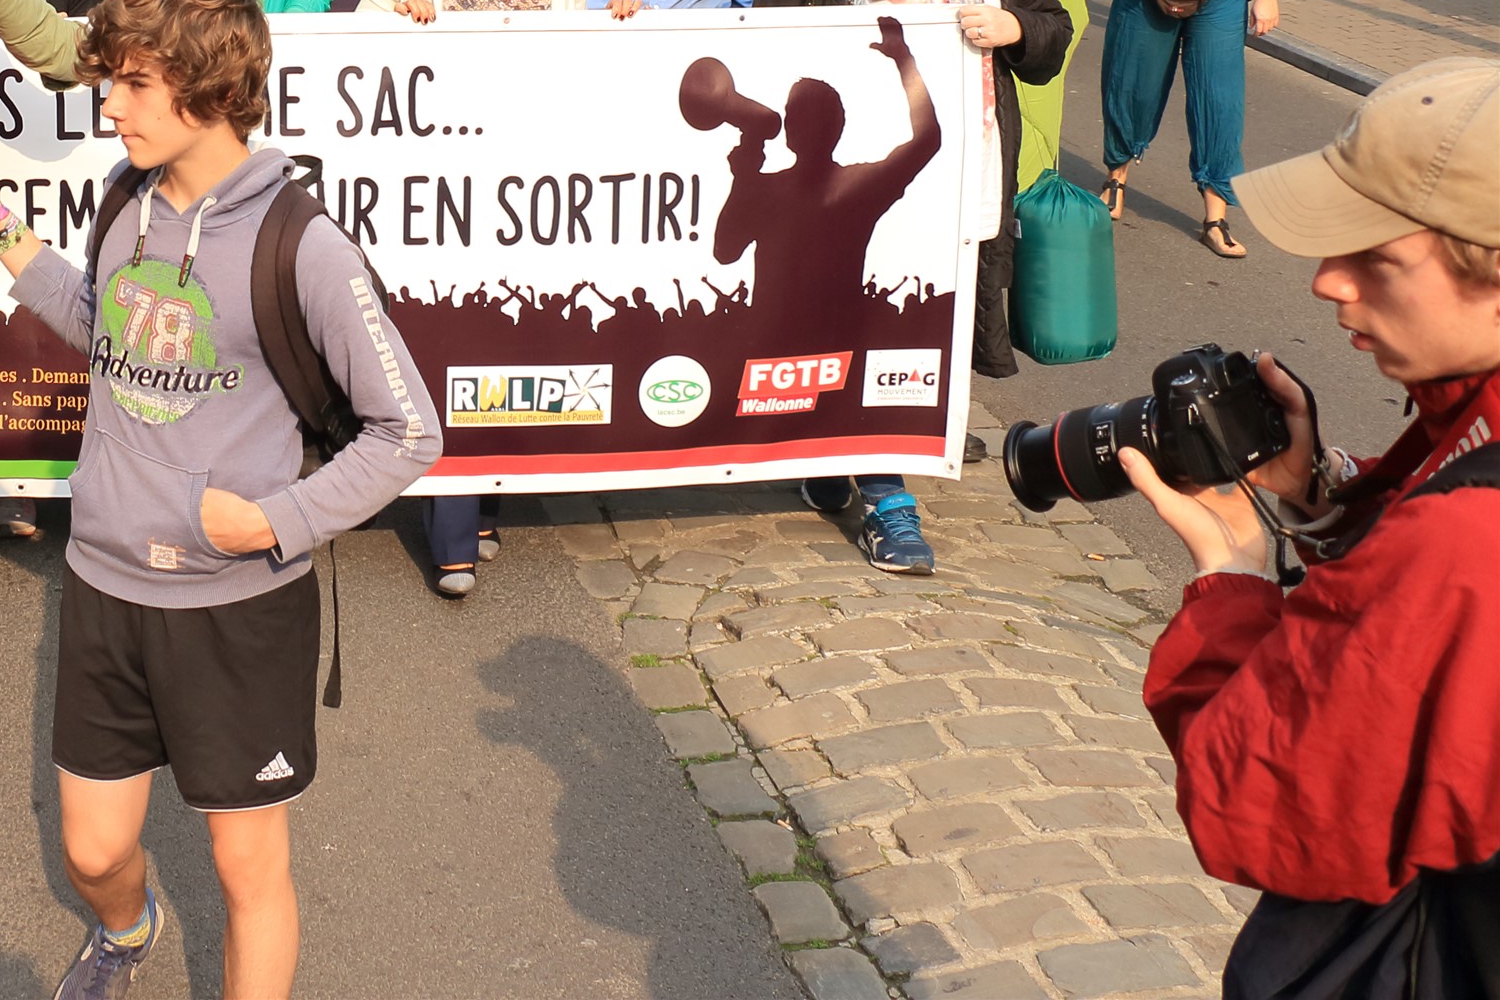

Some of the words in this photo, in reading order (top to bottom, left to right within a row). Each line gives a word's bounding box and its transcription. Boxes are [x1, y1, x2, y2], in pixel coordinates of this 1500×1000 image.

[336, 64, 484, 138] SAC...
[403, 174, 471, 248] EN
[496, 171, 700, 247] SORTIR!
[89, 332, 241, 395] Adventure
[748, 357, 842, 391] FGTB
[31, 367, 91, 385] Deman
[11, 390, 52, 407] Sans
[56, 395, 89, 412] pap
[651, 381, 699, 401] CSC
[741, 396, 814, 413] Wallonne
[452, 412, 479, 424] Réseau
[481, 412, 506, 423] Wallon
[507, 412, 517, 423] de
[519, 411, 538, 422] Lutte
[539, 411, 563, 422] contre
[563, 411, 571, 421] la
[572, 410, 604, 422] Pauvreté
[255, 766, 295, 782] adidas
